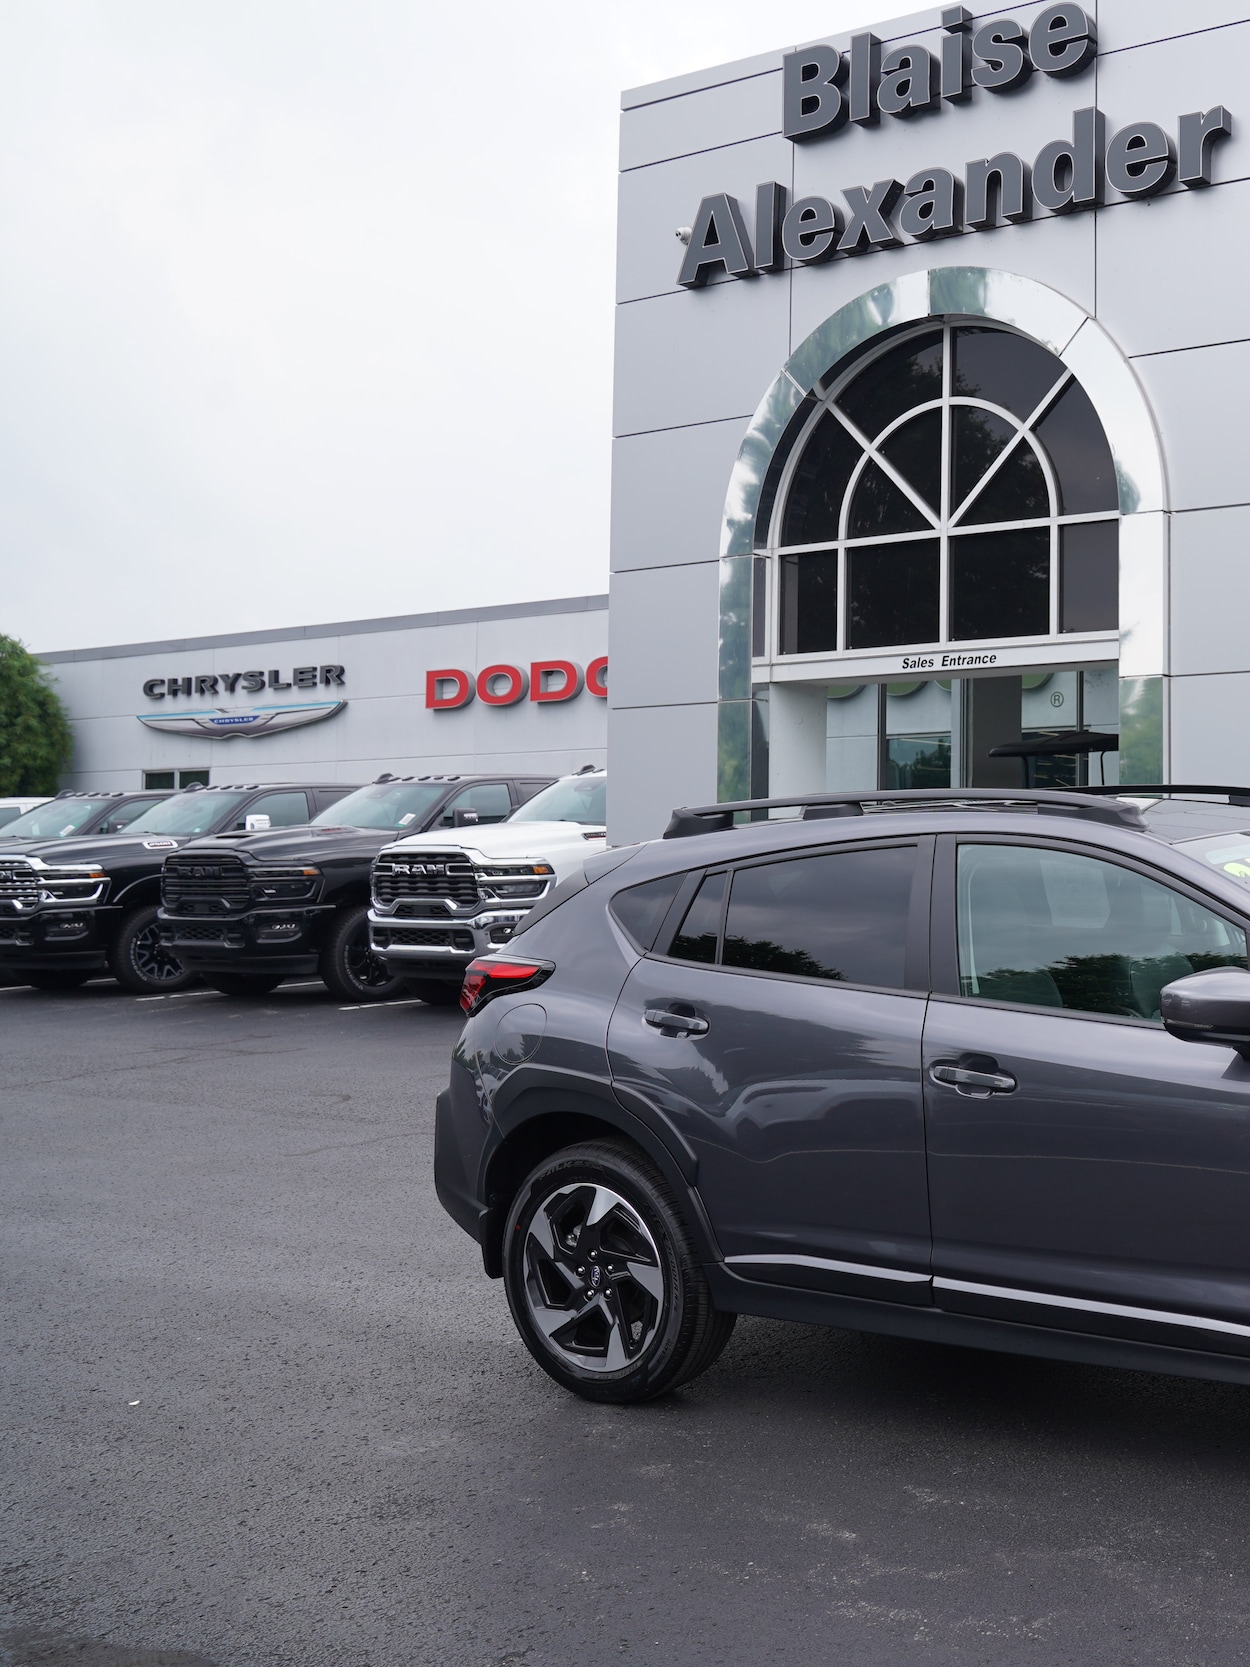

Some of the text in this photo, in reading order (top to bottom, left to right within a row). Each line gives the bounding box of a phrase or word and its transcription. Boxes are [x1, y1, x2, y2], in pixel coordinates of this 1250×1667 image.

[782, 1, 1099, 141] Blaise
[675, 105, 1232, 288] Alexander
[902, 654, 997, 669] Sales Entrance
[143, 664, 346, 699] CHRYSLER
[213, 716, 255, 724] CHRYSLER
[177, 865, 223, 878] RAM
[393, 863, 445, 875] RAM
